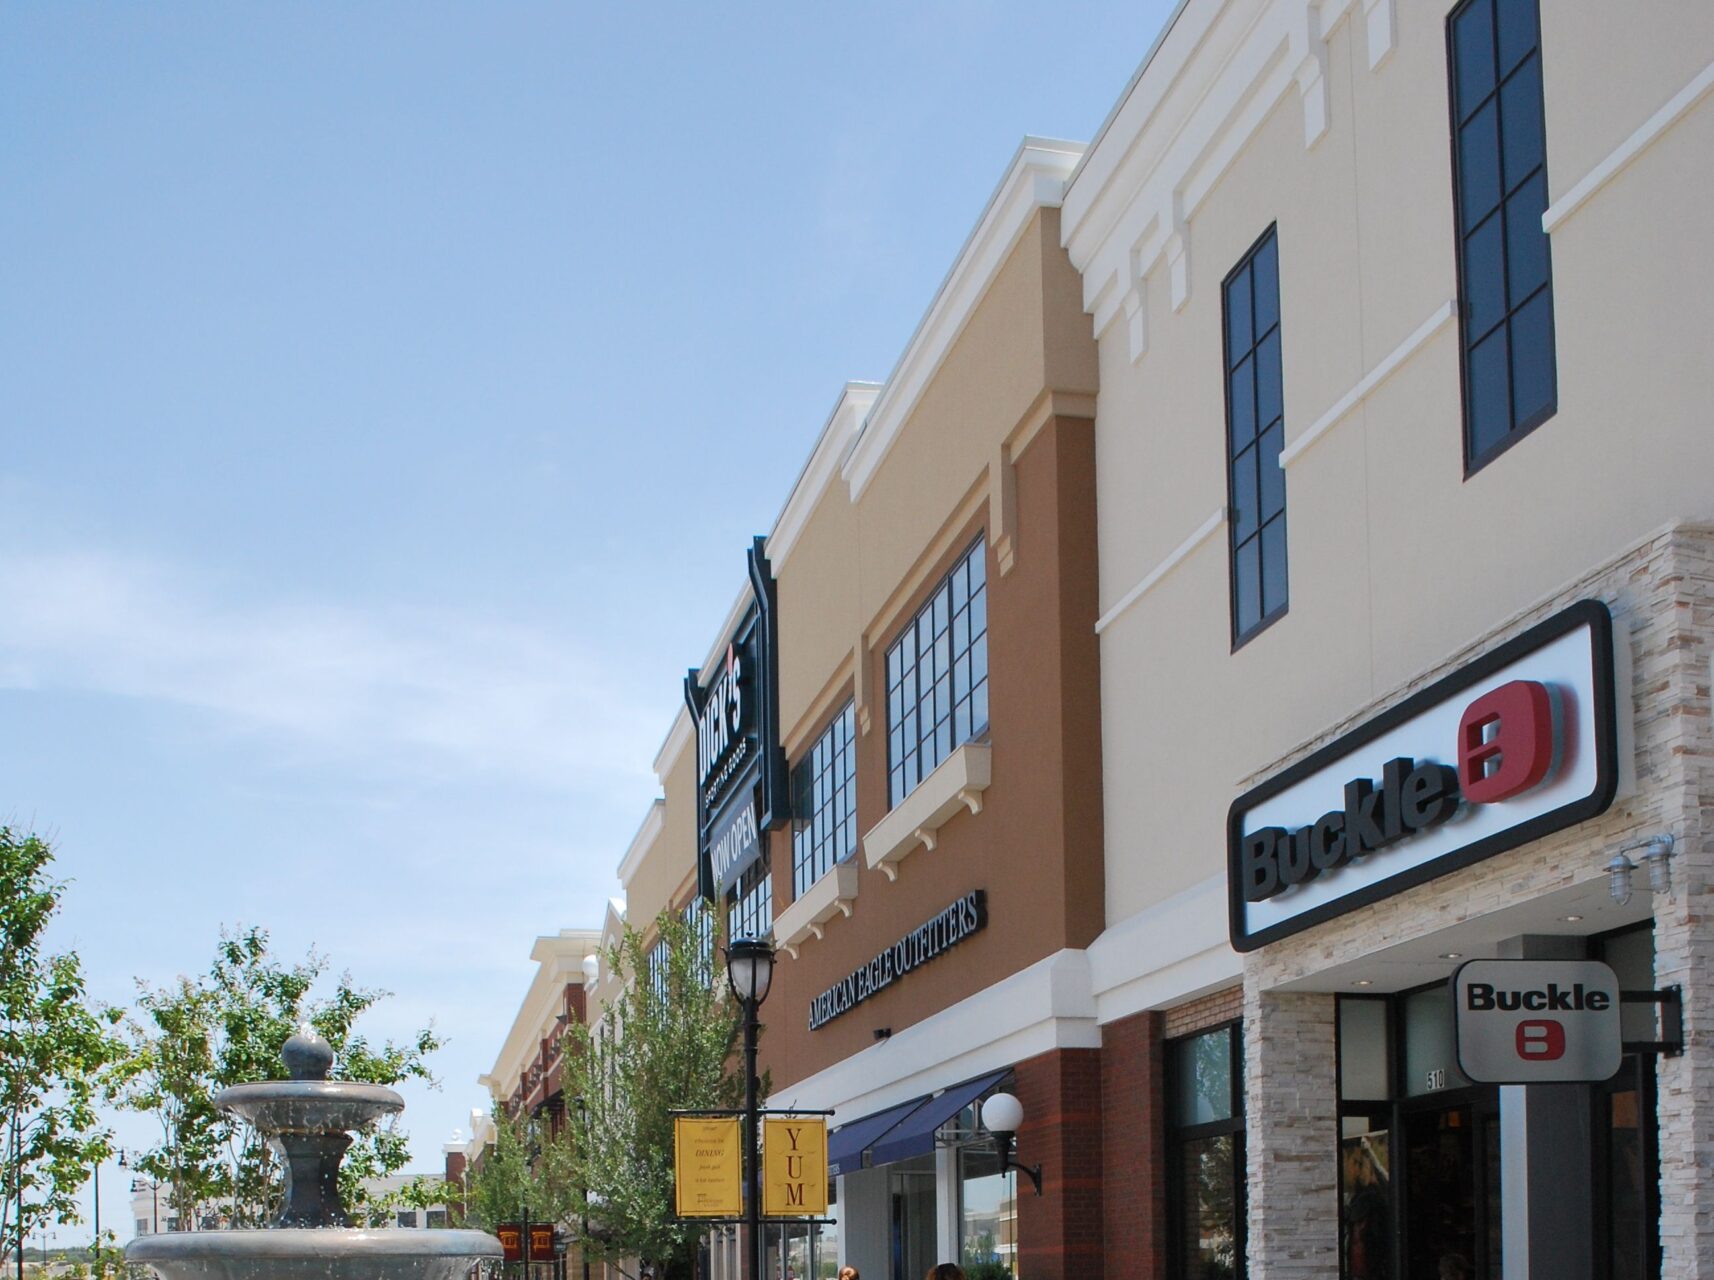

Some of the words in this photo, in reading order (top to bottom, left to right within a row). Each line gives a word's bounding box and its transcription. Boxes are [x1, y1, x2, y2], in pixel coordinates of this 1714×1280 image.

[699, 642, 741, 786] DICK'S
[705, 765, 728, 808] SPORTING
[728, 737, 747, 773] GOODS
[711, 831, 731, 882] NOW
[731, 802, 757, 862] OPEN
[1247, 757, 1459, 902] Buckle
[808, 972, 856, 1032] AMERICAN
[857, 946, 894, 1001] EAGLE
[894, 890, 980, 976] OUTFITTERS
[1466, 982, 1610, 1012] Buckle
[1427, 1069, 1444, 1089] 510
[695, 1149, 725, 1157] DINING
[785, 1127, 805, 1206] YUM
